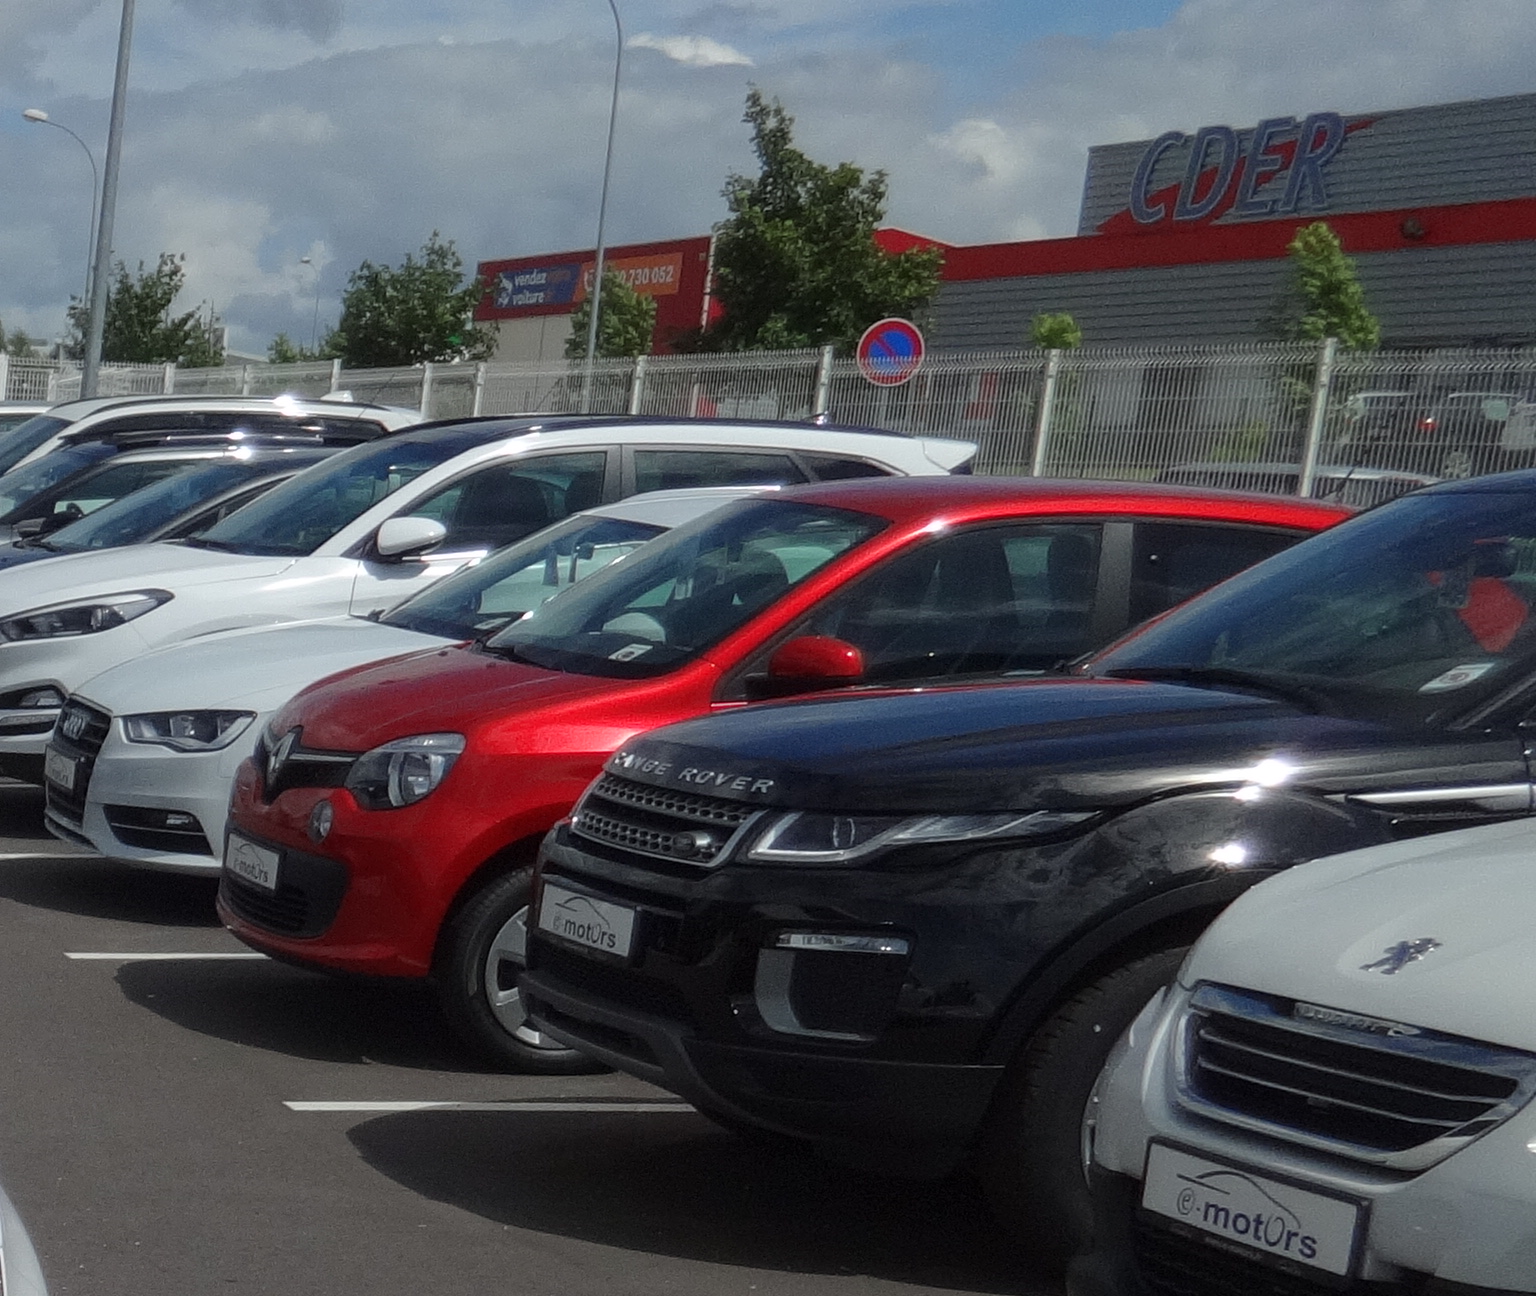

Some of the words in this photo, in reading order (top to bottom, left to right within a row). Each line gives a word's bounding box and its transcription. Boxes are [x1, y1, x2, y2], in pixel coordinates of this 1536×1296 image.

[1129, 112, 1346, 224] CDER
[514, 270, 547, 287] vendez
[512, 291, 544, 305] voiture
[678, 767, 774, 793] ROVER
[1177, 1187, 1318, 1259] e-motors
